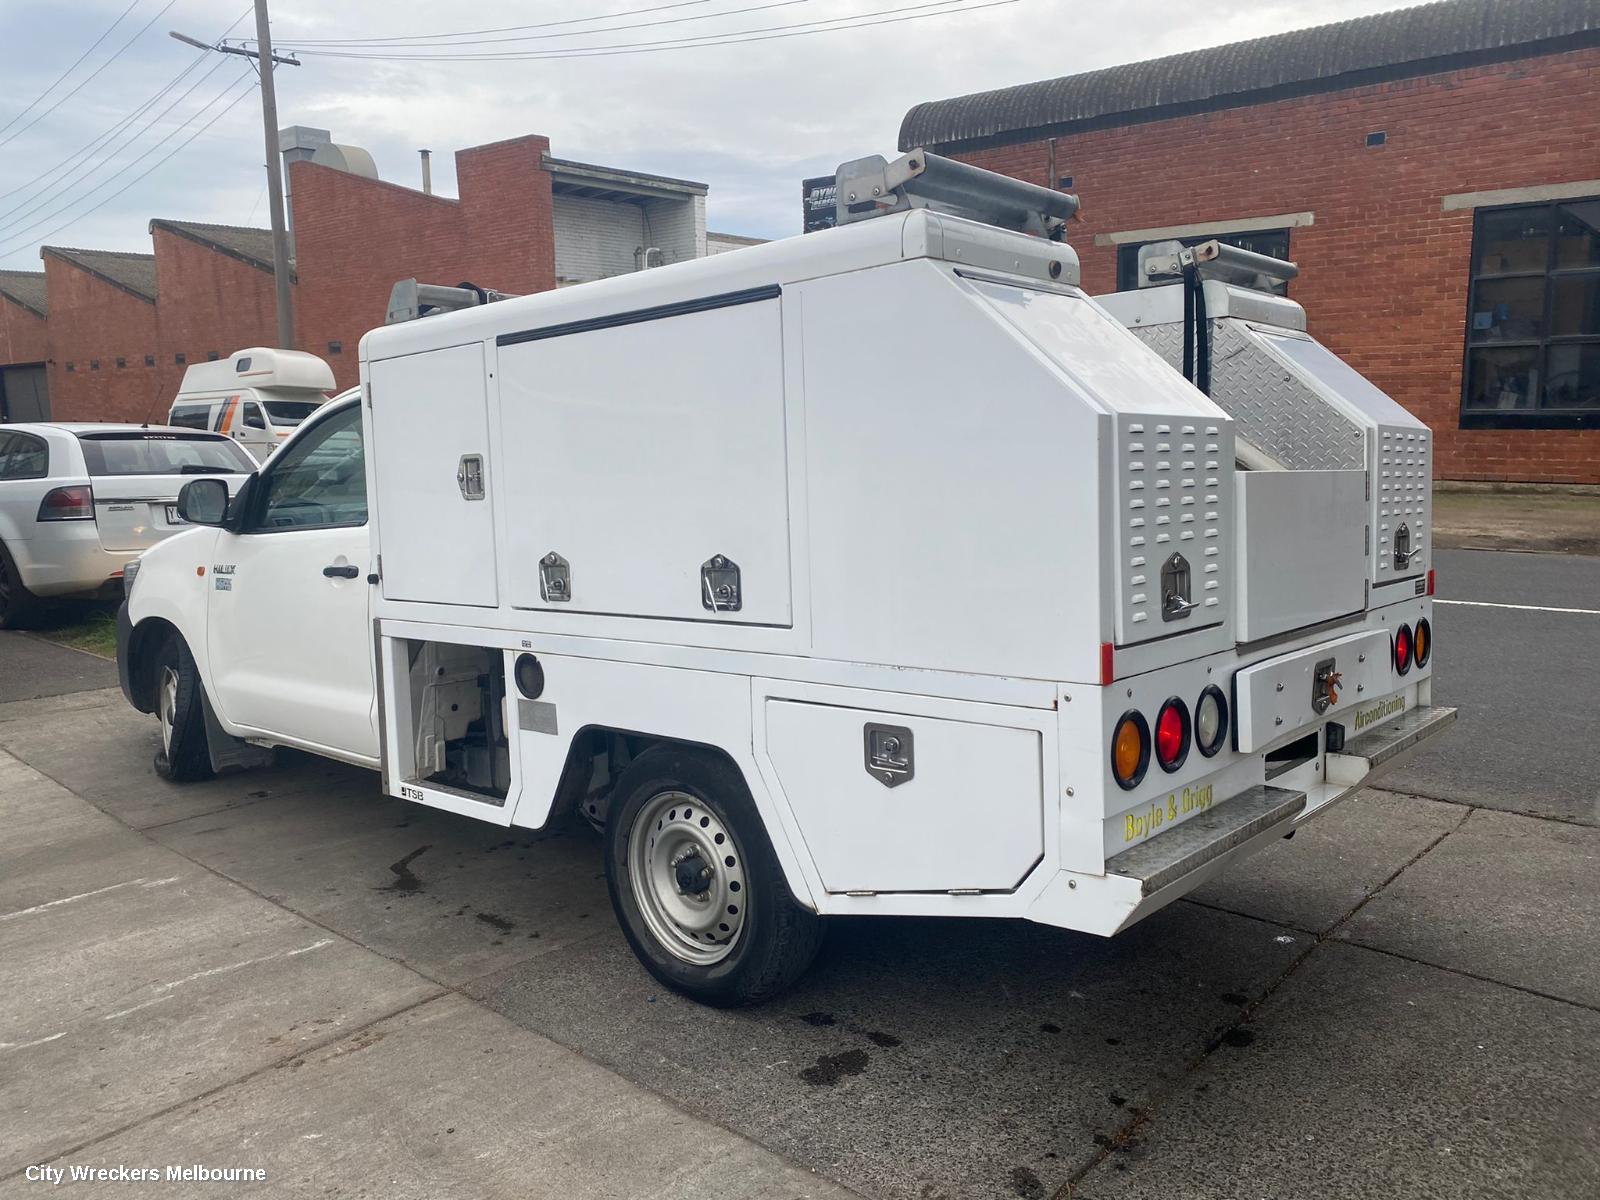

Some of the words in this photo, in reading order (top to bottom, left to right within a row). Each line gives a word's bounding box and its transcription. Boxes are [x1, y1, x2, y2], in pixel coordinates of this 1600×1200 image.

[1354, 695, 1406, 731] Airconditioning
[1125, 803, 1163, 842] Boyle
[1167, 793, 1178, 821] &
